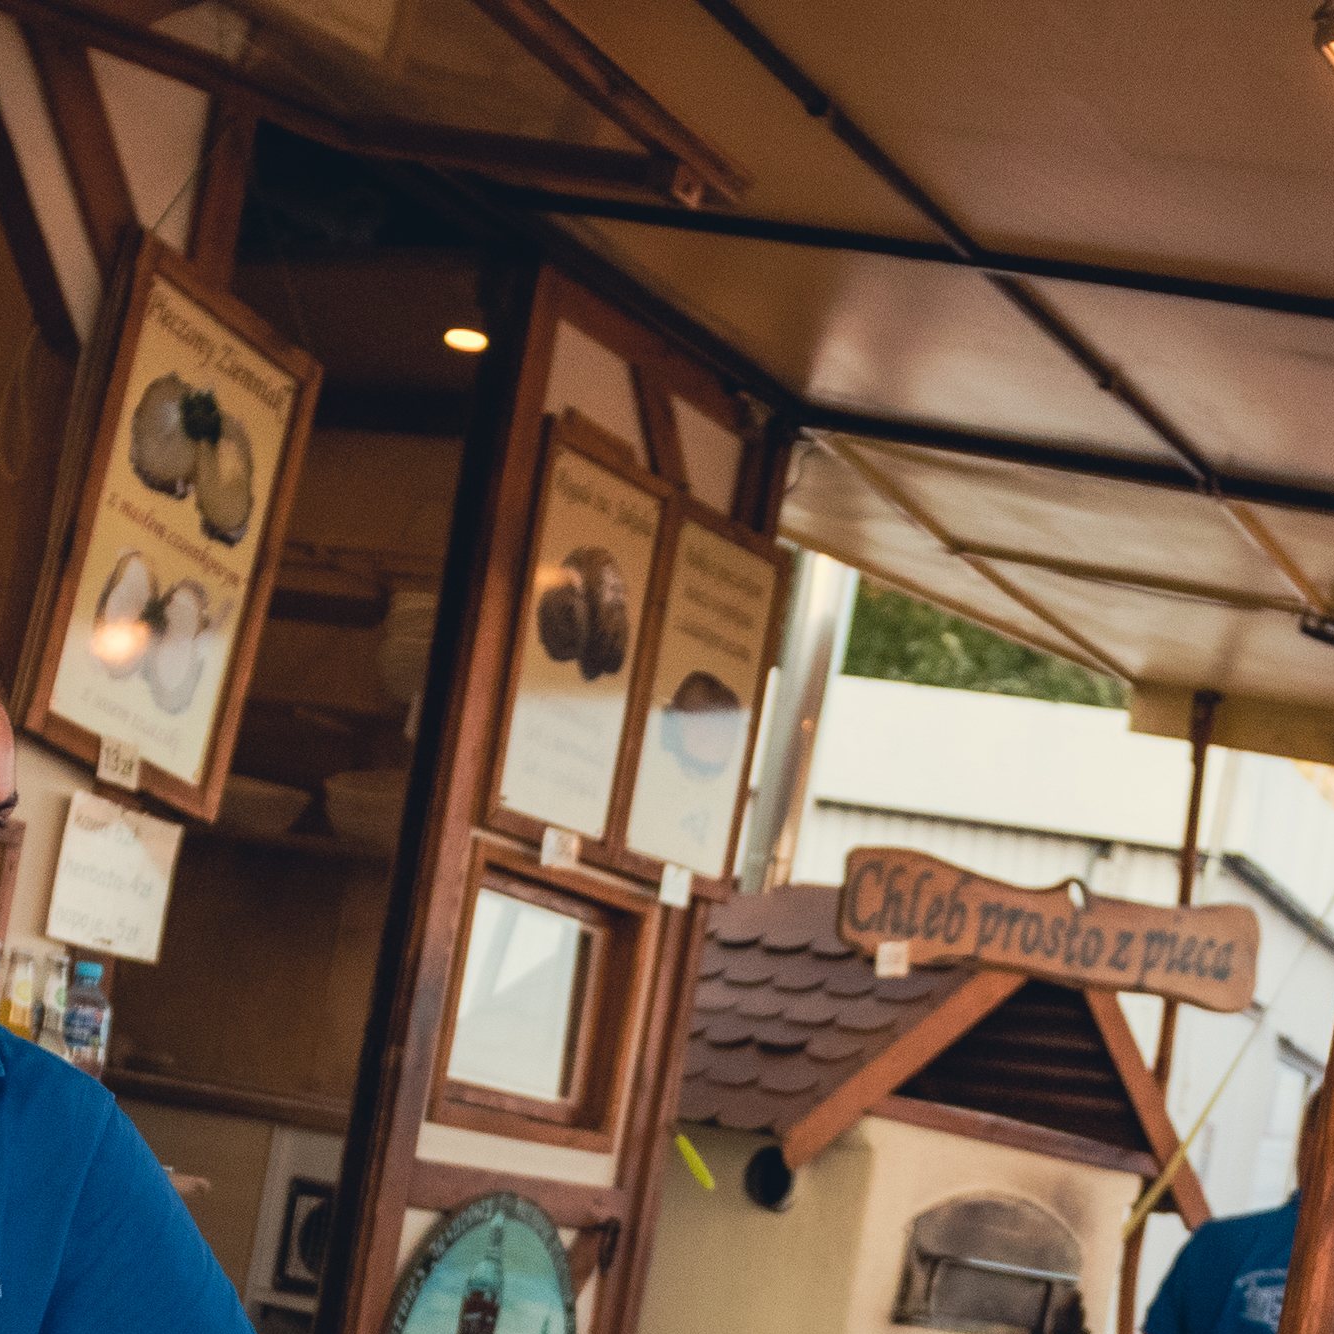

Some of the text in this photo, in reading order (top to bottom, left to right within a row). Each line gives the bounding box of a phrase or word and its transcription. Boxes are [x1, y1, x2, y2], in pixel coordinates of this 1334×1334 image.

[848, 860, 1236, 986] Chleb prosto z pieca
